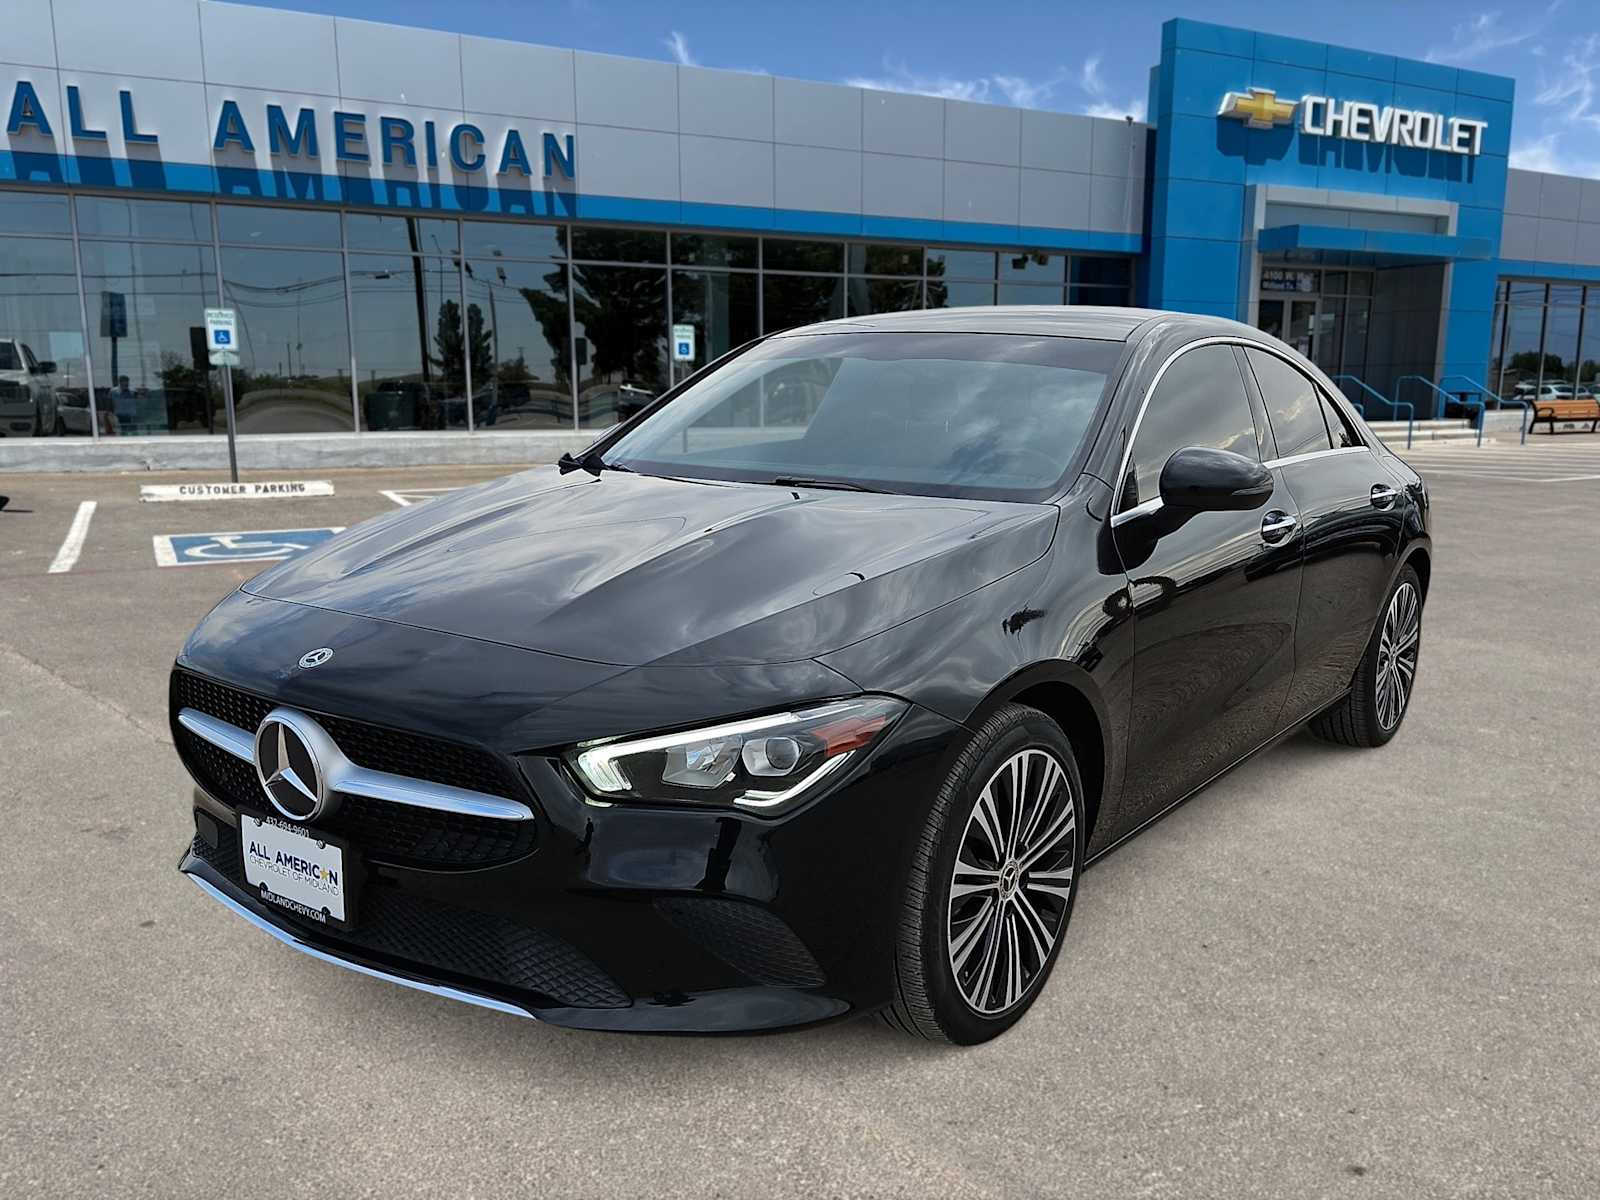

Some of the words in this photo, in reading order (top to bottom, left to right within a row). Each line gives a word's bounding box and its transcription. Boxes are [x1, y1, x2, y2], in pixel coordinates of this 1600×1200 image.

[6, 80, 159, 145] ALL
[213, 99, 576, 179] AMERICAN
[1300, 94, 1488, 155] CHEVROLET
[179, 485, 246, 495] CUSTOMER
[254, 482, 306, 494] PARKING
[249, 841, 271, 861] ALL
[249, 854, 291, 879] CHEVROLET
[292, 871, 303, 881] OF
[304, 876, 340, 897] MIDLAND
[260, 889, 327, 924] MIDLANDCHEVY.COM
